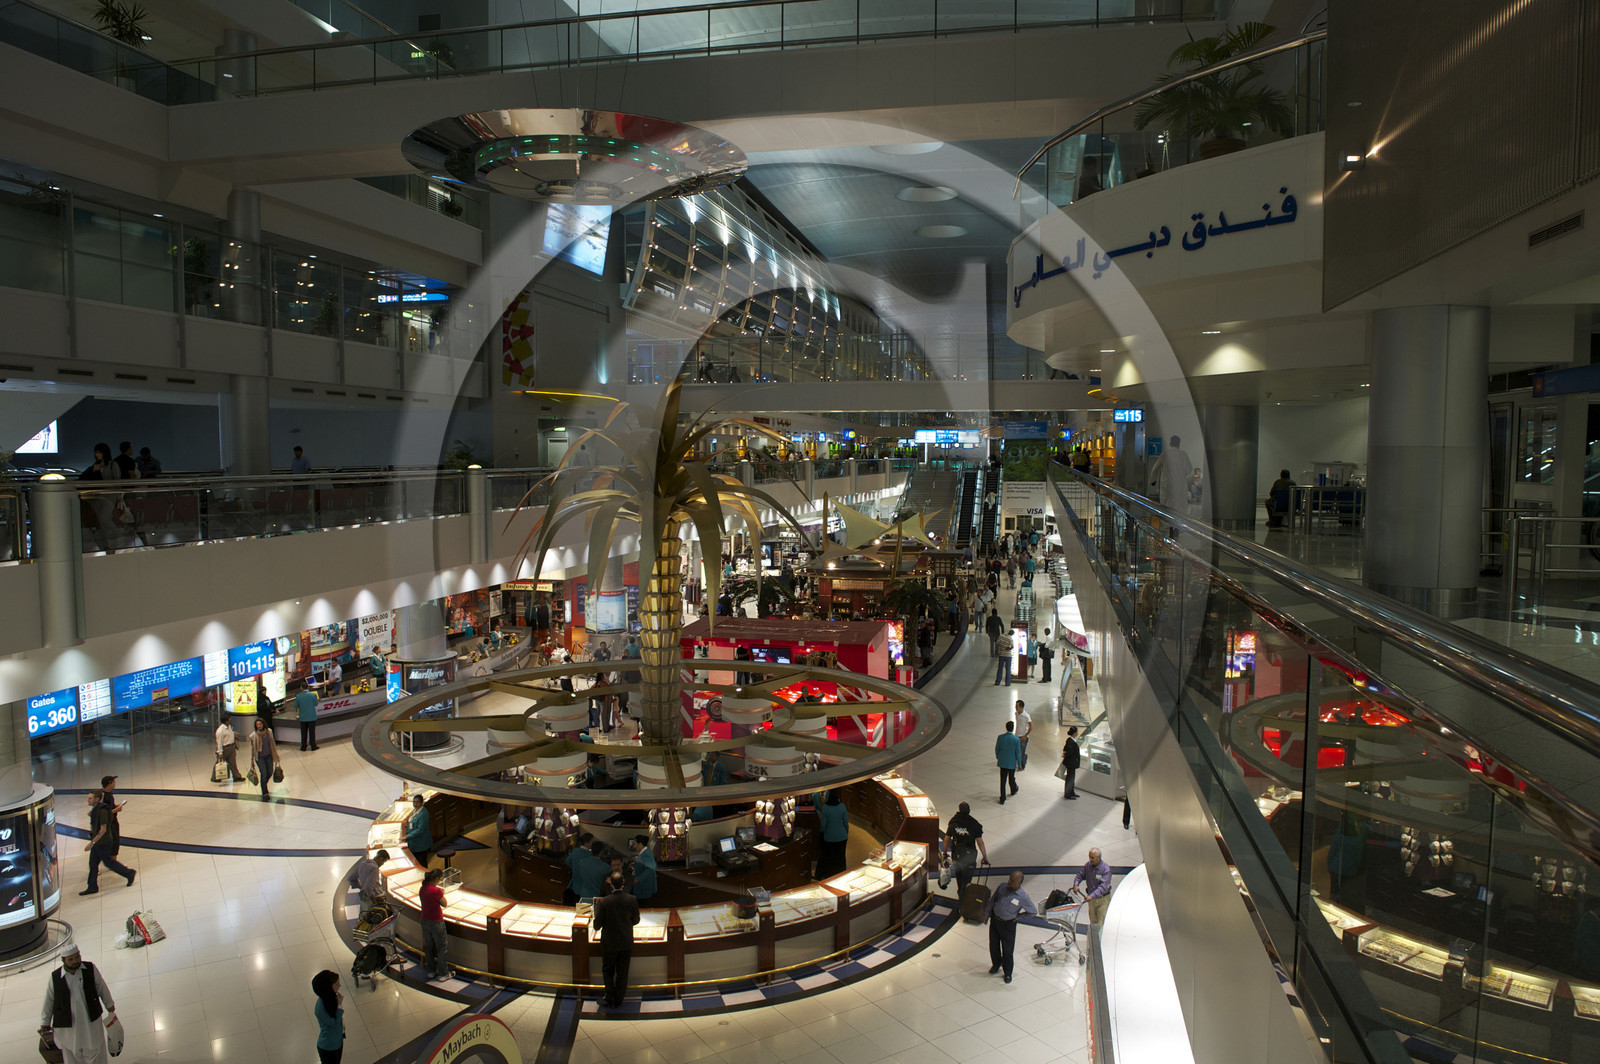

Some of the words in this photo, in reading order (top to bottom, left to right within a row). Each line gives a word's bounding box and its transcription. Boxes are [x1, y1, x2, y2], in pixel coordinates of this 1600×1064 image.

[1181, 186, 1298, 251] فندق
[1092, 225, 1171, 281] دبي
[1124, 409, 1142, 422] 115
[361, 612, 389, 625] $2,000,000
[363, 623, 388, 637] DOUBLE
[245, 646, 262, 655] Gates
[232, 653, 275, 677] 101-115
[409, 668, 445, 680] Marlboro
[31, 696, 56, 709] Gates
[323, 699, 351, 711] DHL
[748, 764, 768, 776] 22K
[567, 771, 587, 785] 22K
[442, 1023, 481, 1063] Maybach
